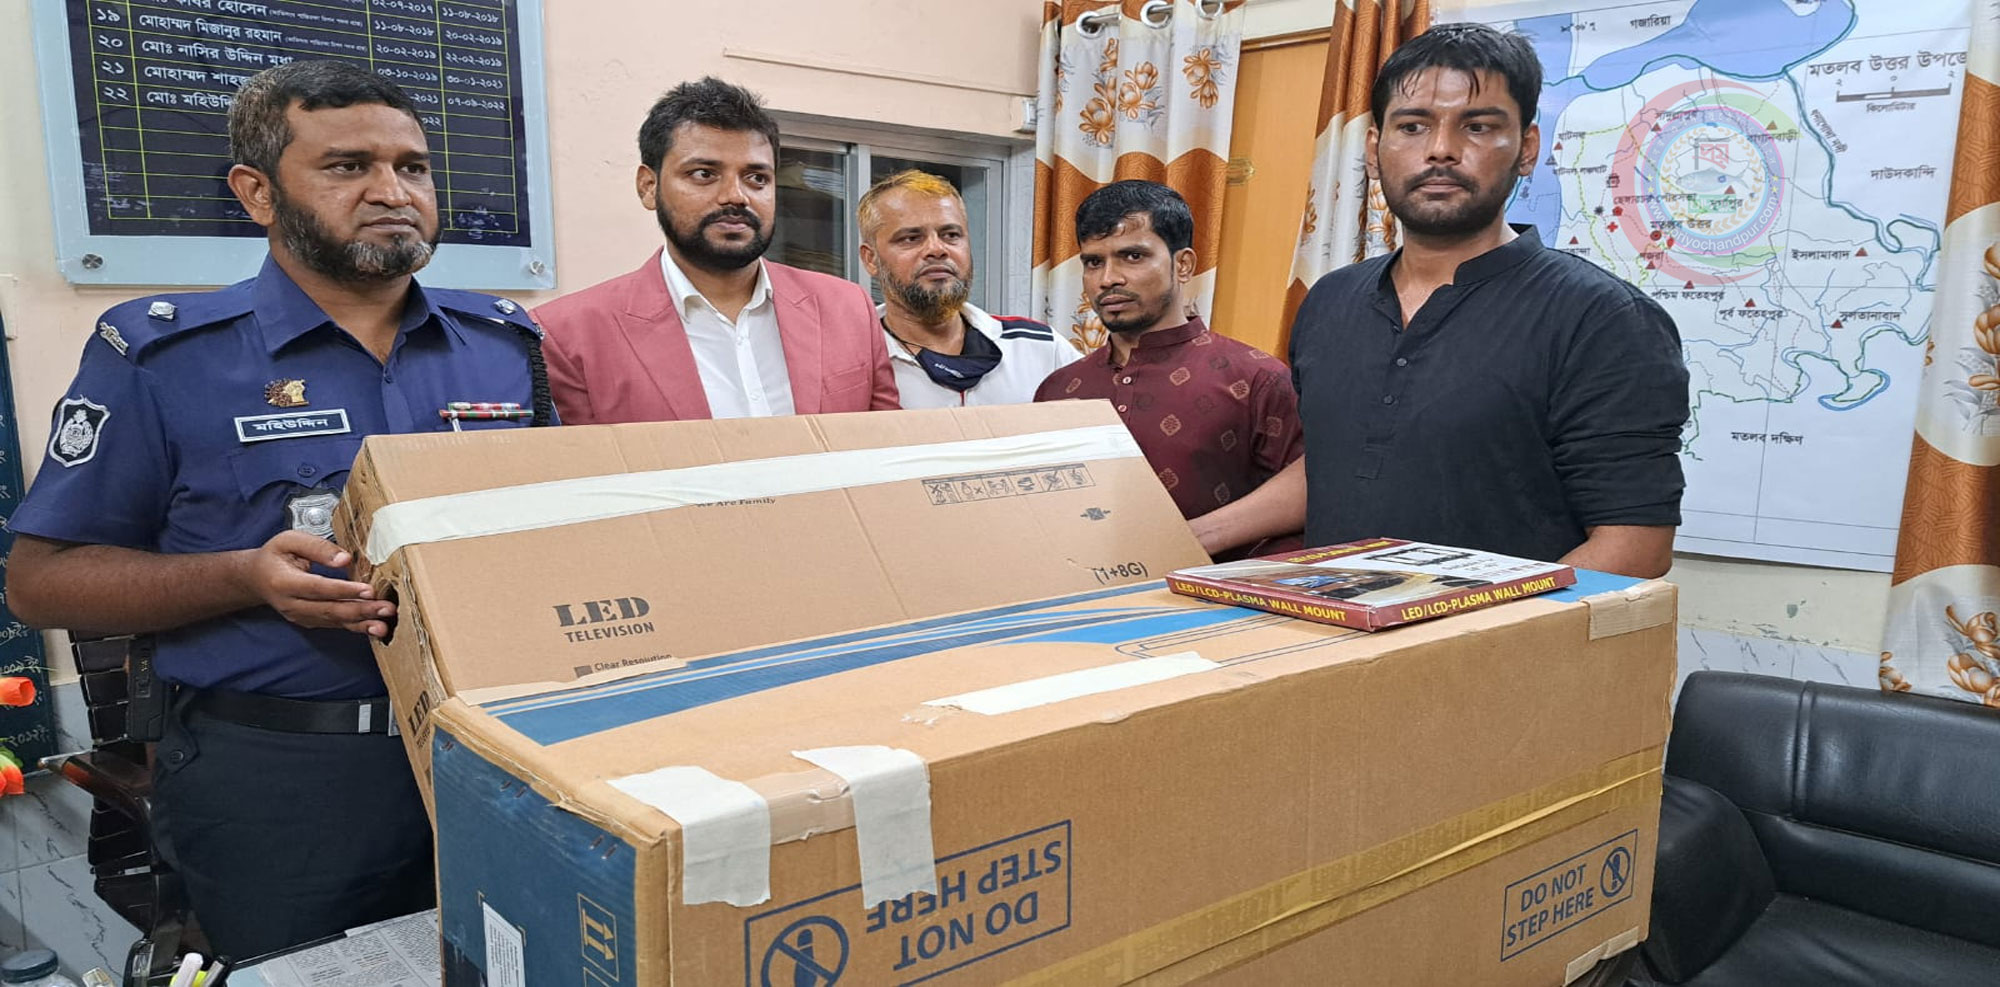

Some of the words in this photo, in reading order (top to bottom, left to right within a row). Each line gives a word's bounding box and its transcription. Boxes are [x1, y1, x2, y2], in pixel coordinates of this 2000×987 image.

[96, 8, 121, 22] ১৯
[217, 0, 267, 16] হোসেন
[442, 6, 499, 23] ১১-০৮-২০১৮
[139, 14, 191, 31] মোহাম্মদ
[195, 18, 241, 40] মিজানুর
[244, 27, 282, 42] রহমান
[375, 20, 434, 36] ১১-০৮-২০১৮
[98, 34, 123, 49] ২০
[446, 29, 503, 46] ২০-০২-২০১৯
[142, 40, 173, 55] মোঃ
[178, 43, 219, 60] নাসির
[224, 46, 263, 65] উদ্দিন
[376, 44, 437, 60] ২০-০২-২০১৯
[102, 60, 125, 75] ২১
[144, 65, 206, 83] মোহাম্মদ
[1808, 60, 1863, 77] মতলব
[1869, 54, 1911, 72] উত্তর
[104, 86, 129, 101] ২২
[146, 90, 177, 106] মোঃ
[1870, 165, 1938, 180] দাউদকান্দি
[1792, 249, 1851, 261] ইসলামাবাদ
[1840, 311, 1902, 323] সুলতানাবাদ
[251, 417, 329, 433] মহিউদ্দিন
[1731, 431, 1767, 443] মতলব
[1175, 582, 1267, 607] LED/LCD-PLASMA
[1269, 598, 1301, 614] WALL
[1302, 605, 1347, 622] MOUNT
[1401, 591, 1493, 621] LED/LCD-PLASMA
[1493, 584, 1522, 600] WALL
[1522, 576, 1557, 593] MOUNT
[553, 597, 650, 627] LED
[564, 622, 655, 643] TELEVISION
[594, 662, 620, 672] Clear
[408, 690, 430, 737] LED
[977, 840, 1062, 895] STEP
[1520, 883, 1547, 912] DO
[1551, 864, 1587, 898] NOT
[866, 870, 966, 934] HERE
[985, 890, 1038, 935] DO
[1506, 909, 1549, 947] STEP
[1552, 887, 1594, 925] HERE
[893, 912, 974, 971] NOT
